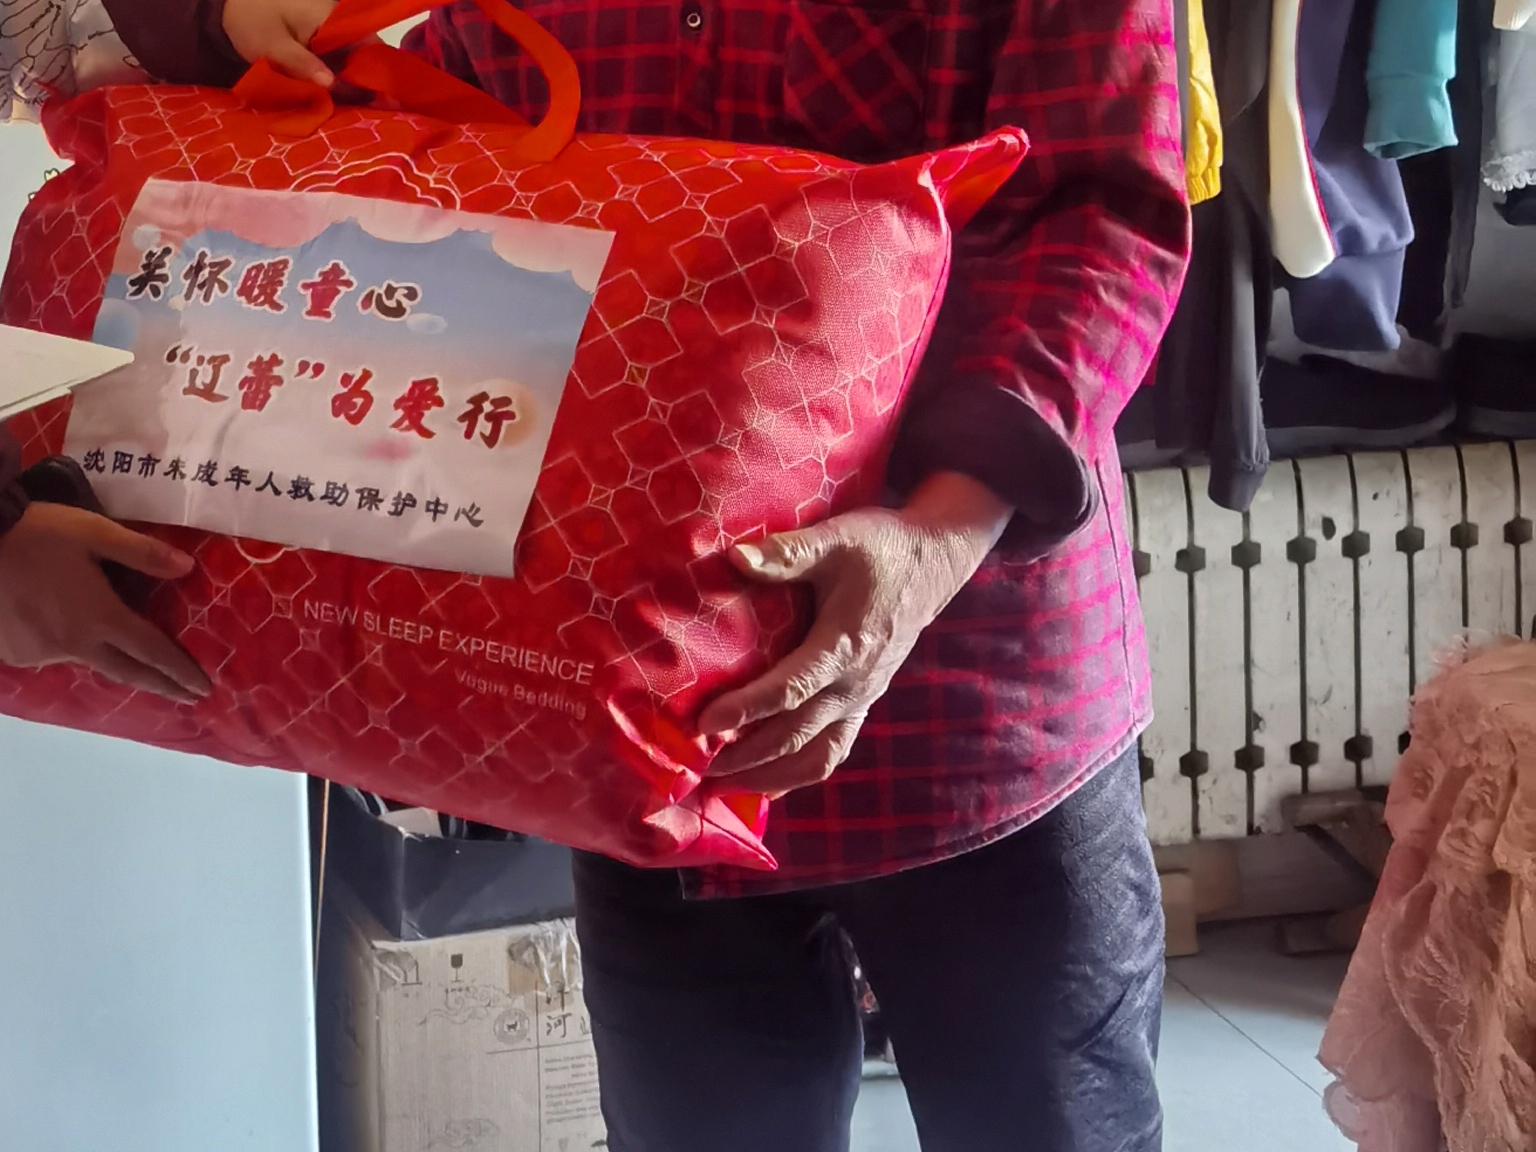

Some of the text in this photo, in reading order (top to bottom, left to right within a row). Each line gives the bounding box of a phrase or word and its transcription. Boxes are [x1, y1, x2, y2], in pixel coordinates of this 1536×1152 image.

[127, 246, 421, 321] 关怀暖童心
[83, 449, 485, 528] 沈阳市未成年人救助保护中心
[303, 599, 595, 686] NEW SLEEP EXPERIENCE
[513, 683, 587, 721] Bedding
